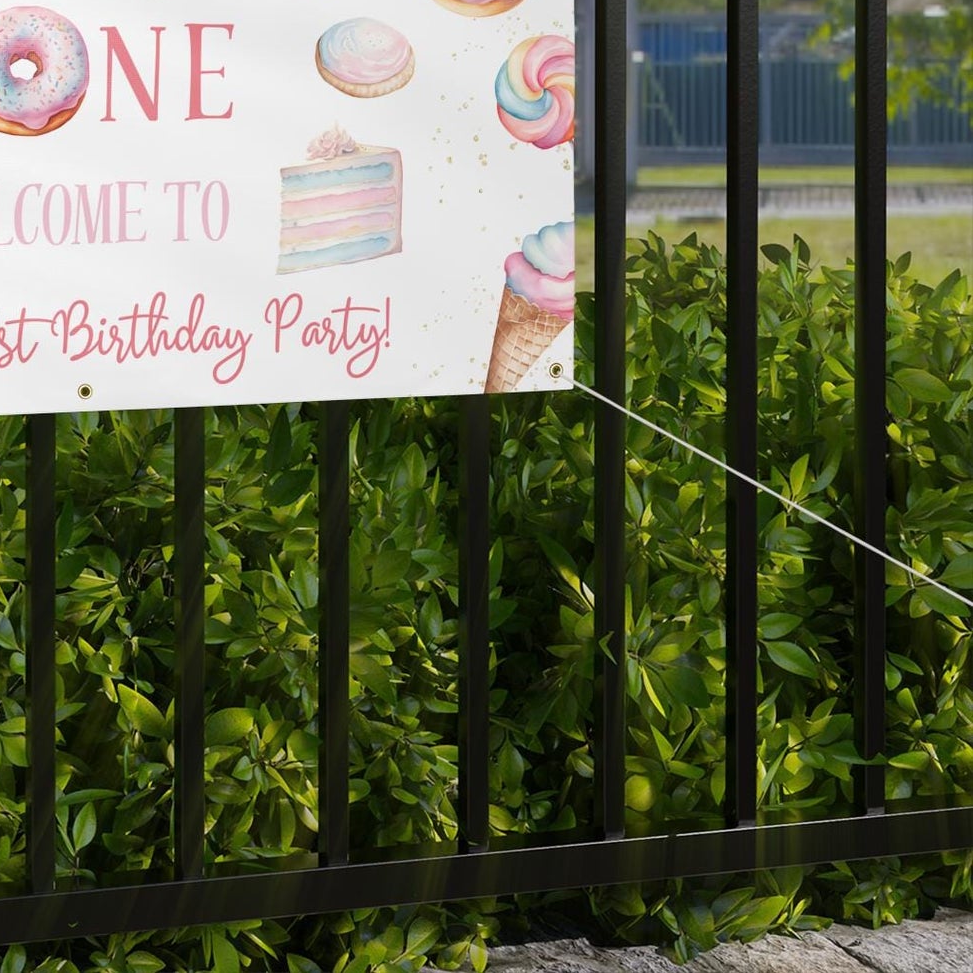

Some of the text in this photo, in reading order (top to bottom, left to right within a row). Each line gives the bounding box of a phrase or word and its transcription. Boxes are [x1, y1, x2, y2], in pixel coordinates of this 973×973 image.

[163, 180, 230, 242] TO
[51, 291, 253, 385] Birthday
[264, 292, 392, 379] Party!
